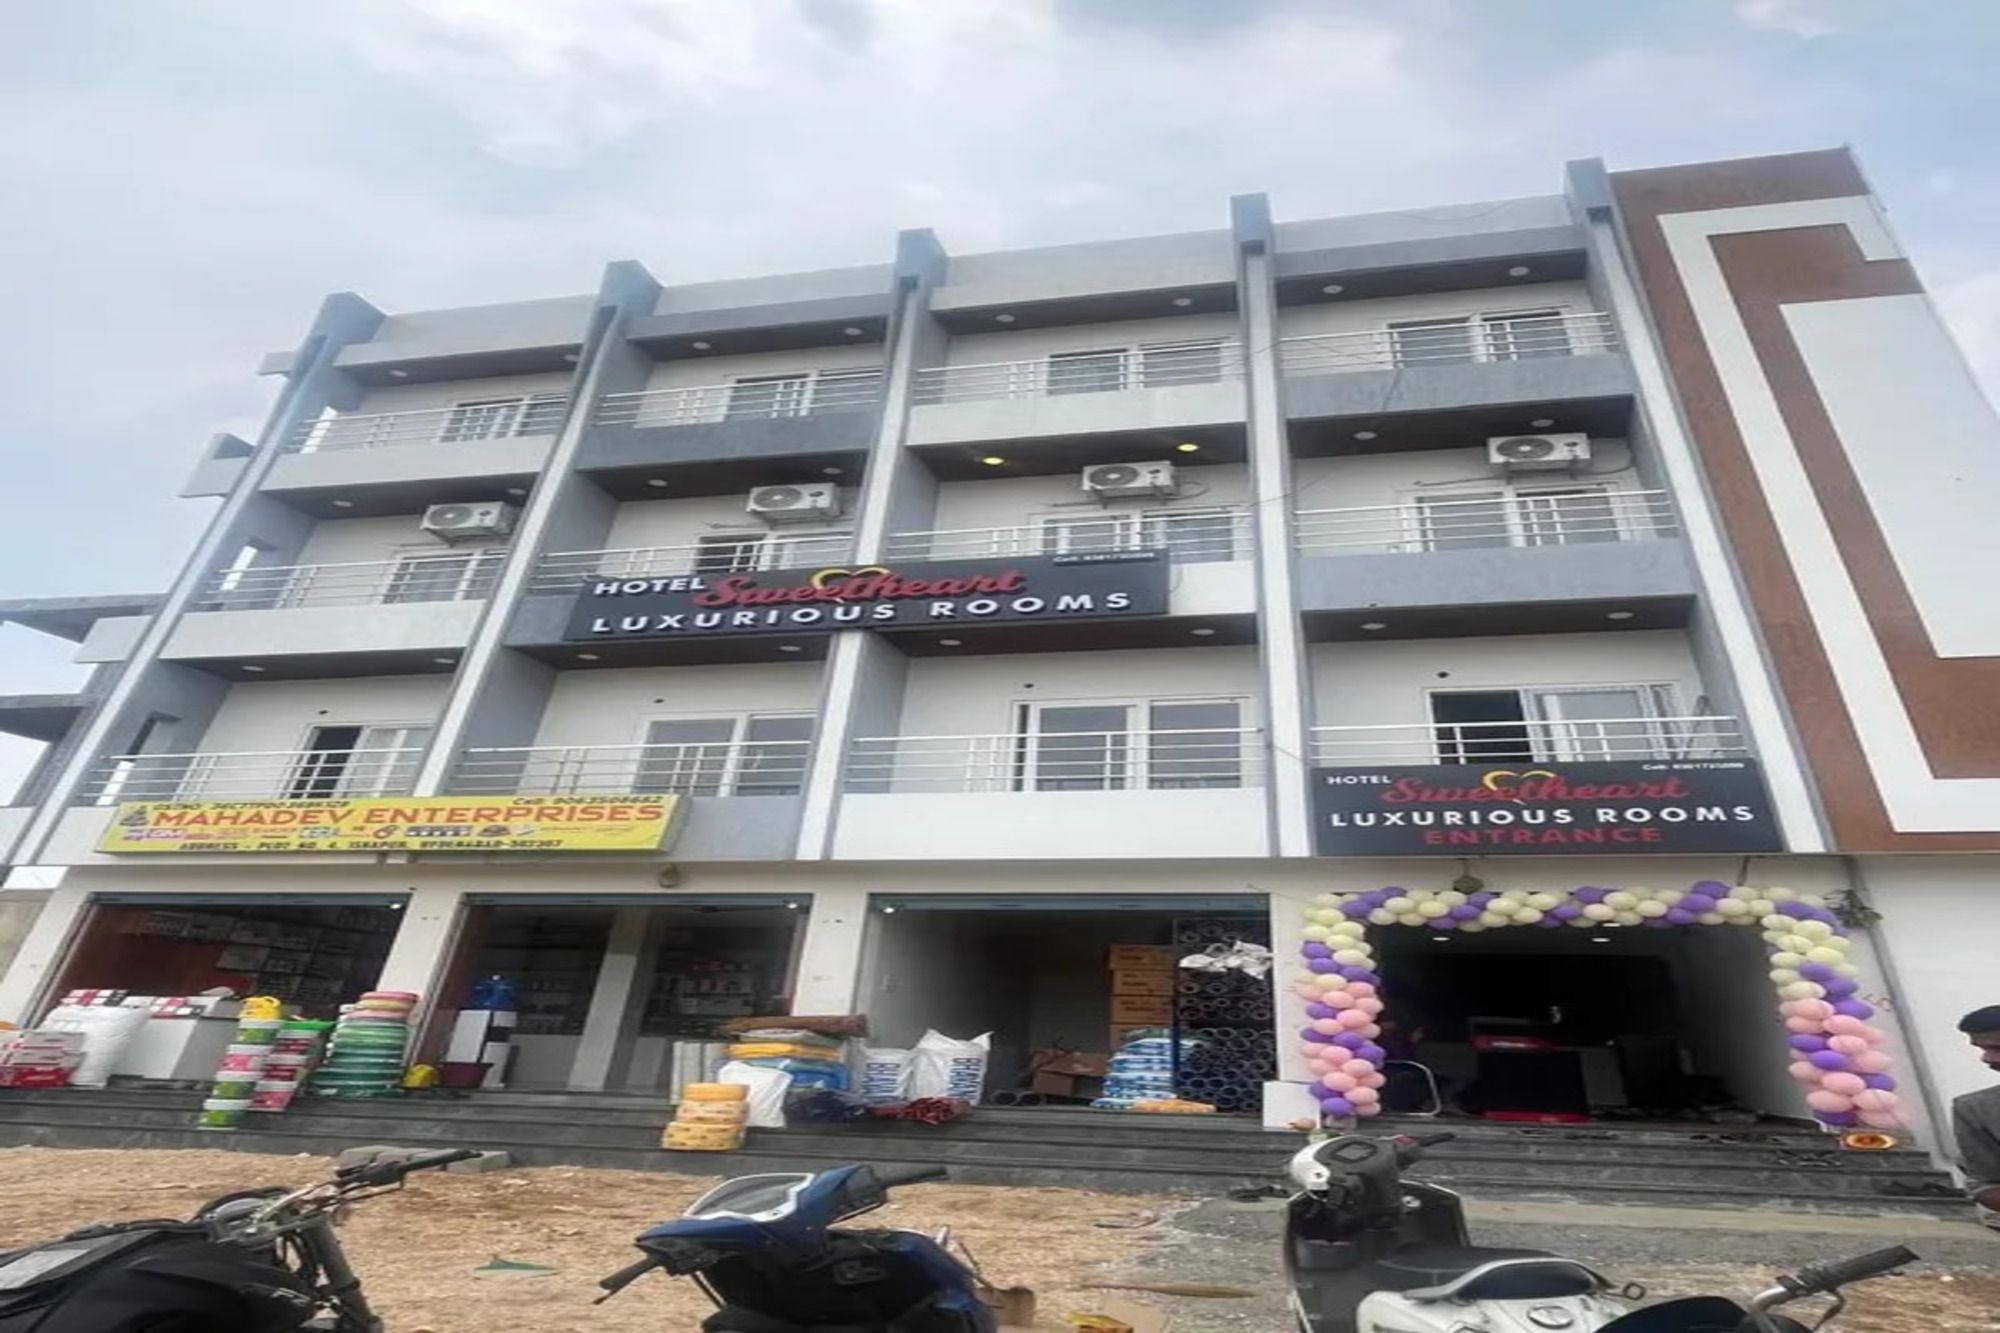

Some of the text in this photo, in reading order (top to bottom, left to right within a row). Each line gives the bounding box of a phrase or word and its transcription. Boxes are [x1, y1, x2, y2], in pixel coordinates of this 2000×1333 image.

[594, 569, 1027, 608] HOTEL Sweetheart
[592, 592, 1130, 632] LUXURIOUS ROOMS
[1327, 775, 1690, 804] HOTEL Sweetheart
[153, 805, 665, 827] MAHADEV ENTERPRISES
[1331, 806, 1755, 827] LUXURIOUS ROOMS
[1424, 827, 1664, 845] ENTRANCE
